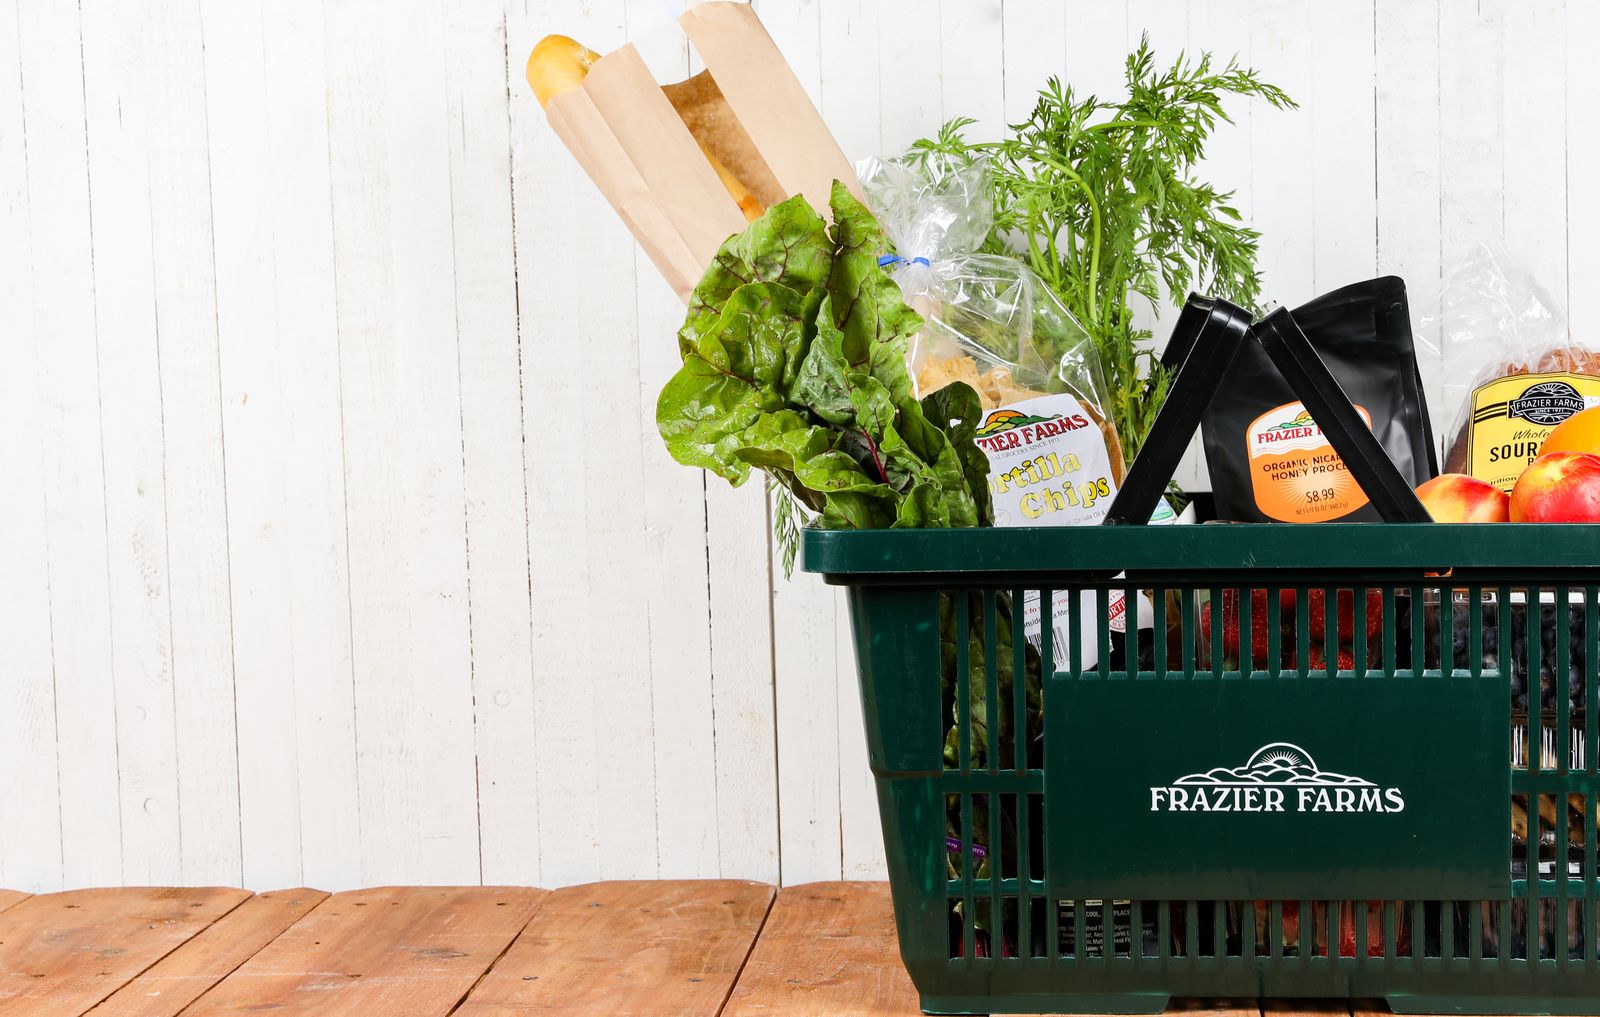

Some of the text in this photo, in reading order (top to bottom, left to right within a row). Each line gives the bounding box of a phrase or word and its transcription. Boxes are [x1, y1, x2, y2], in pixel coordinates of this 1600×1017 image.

[1516, 399, 1584, 411] FRAZIER FARMS
[1021, 414, 1089, 444] FARMS
[1257, 427, 1313, 444] FRAZIER
[1512, 429, 1549, 441] Whole
[1490, 442, 1544, 462] SOUR
[1263, 457, 1309, 472] ORGANIC
[1272, 467, 1309, 481] HONEY
[1490, 476, 1517, 486] trition
[1019, 477, 1110, 519] Chips
[1305, 487, 1335, 504] $8.99
[1150, 786, 1405, 813] FRAZIER FARMS
